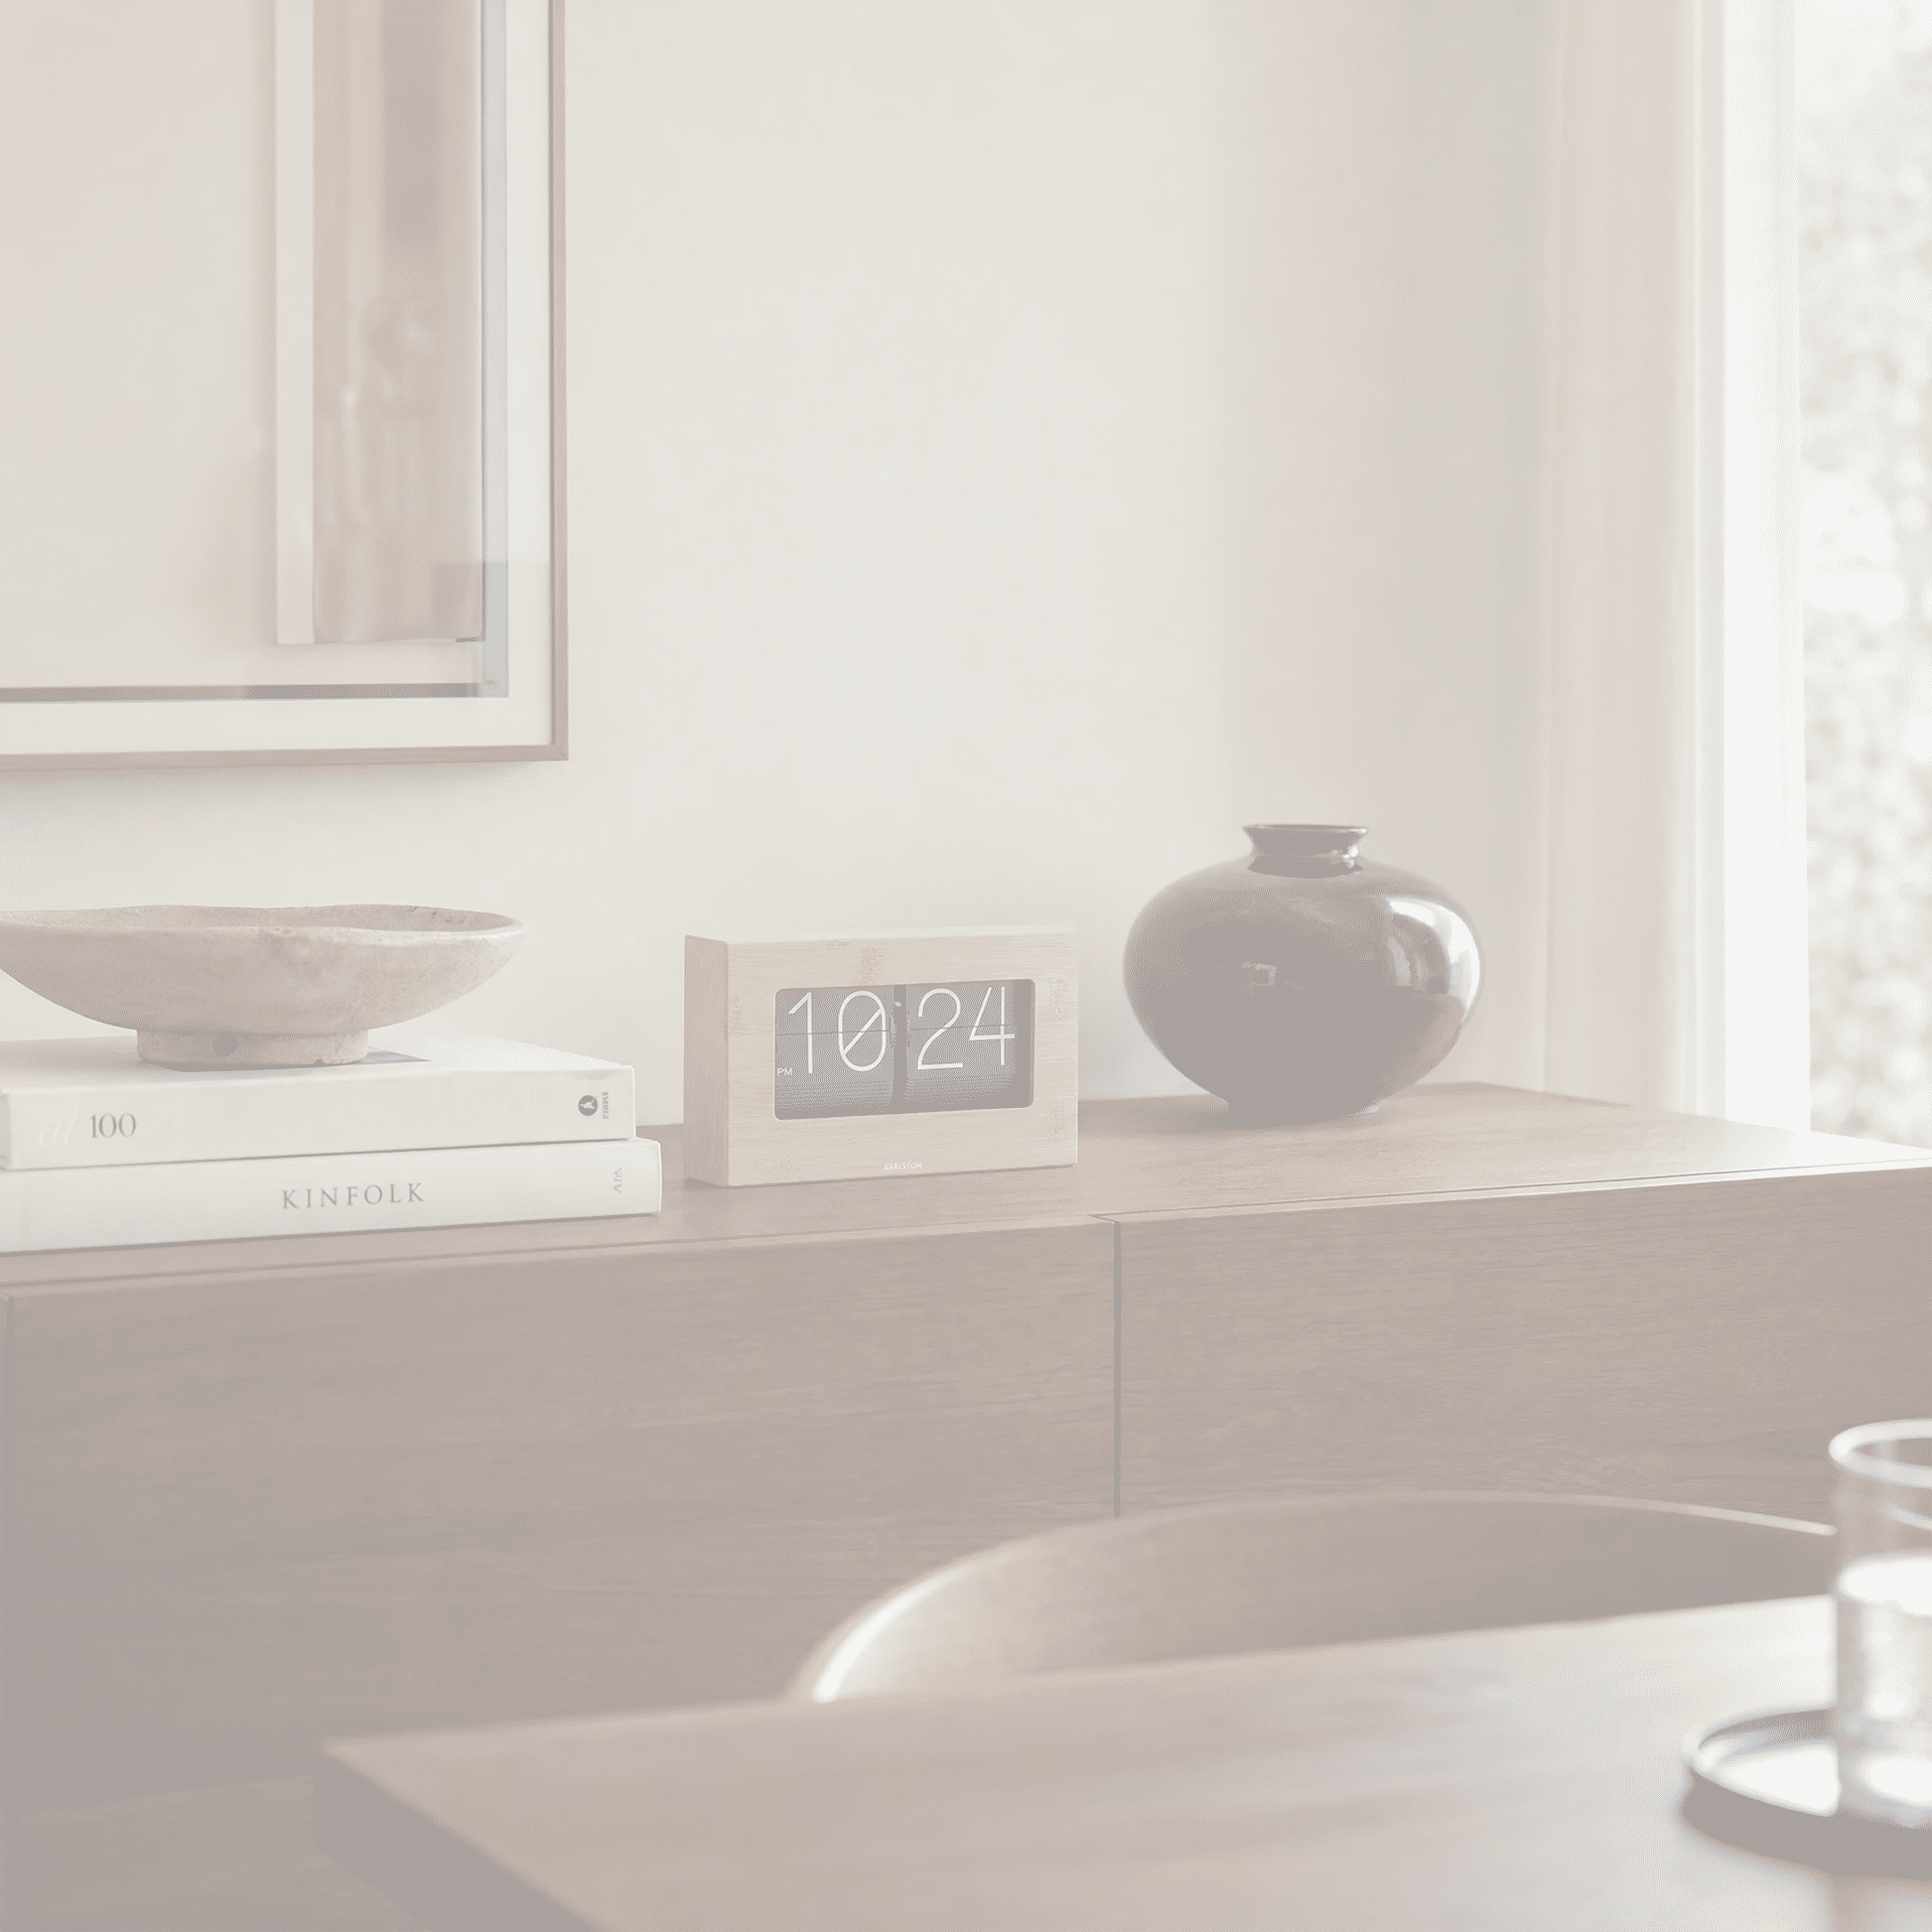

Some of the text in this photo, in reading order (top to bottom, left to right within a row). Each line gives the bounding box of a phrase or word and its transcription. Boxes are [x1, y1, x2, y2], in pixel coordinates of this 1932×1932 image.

[787, 986, 1016, 1074] 10 24
[777, 1067, 793, 1076] PM
[89, 1112, 137, 1139] 100
[884, 1161, 922, 1171] KARLSSON
[281, 1181, 426, 1210] KINFOLK
